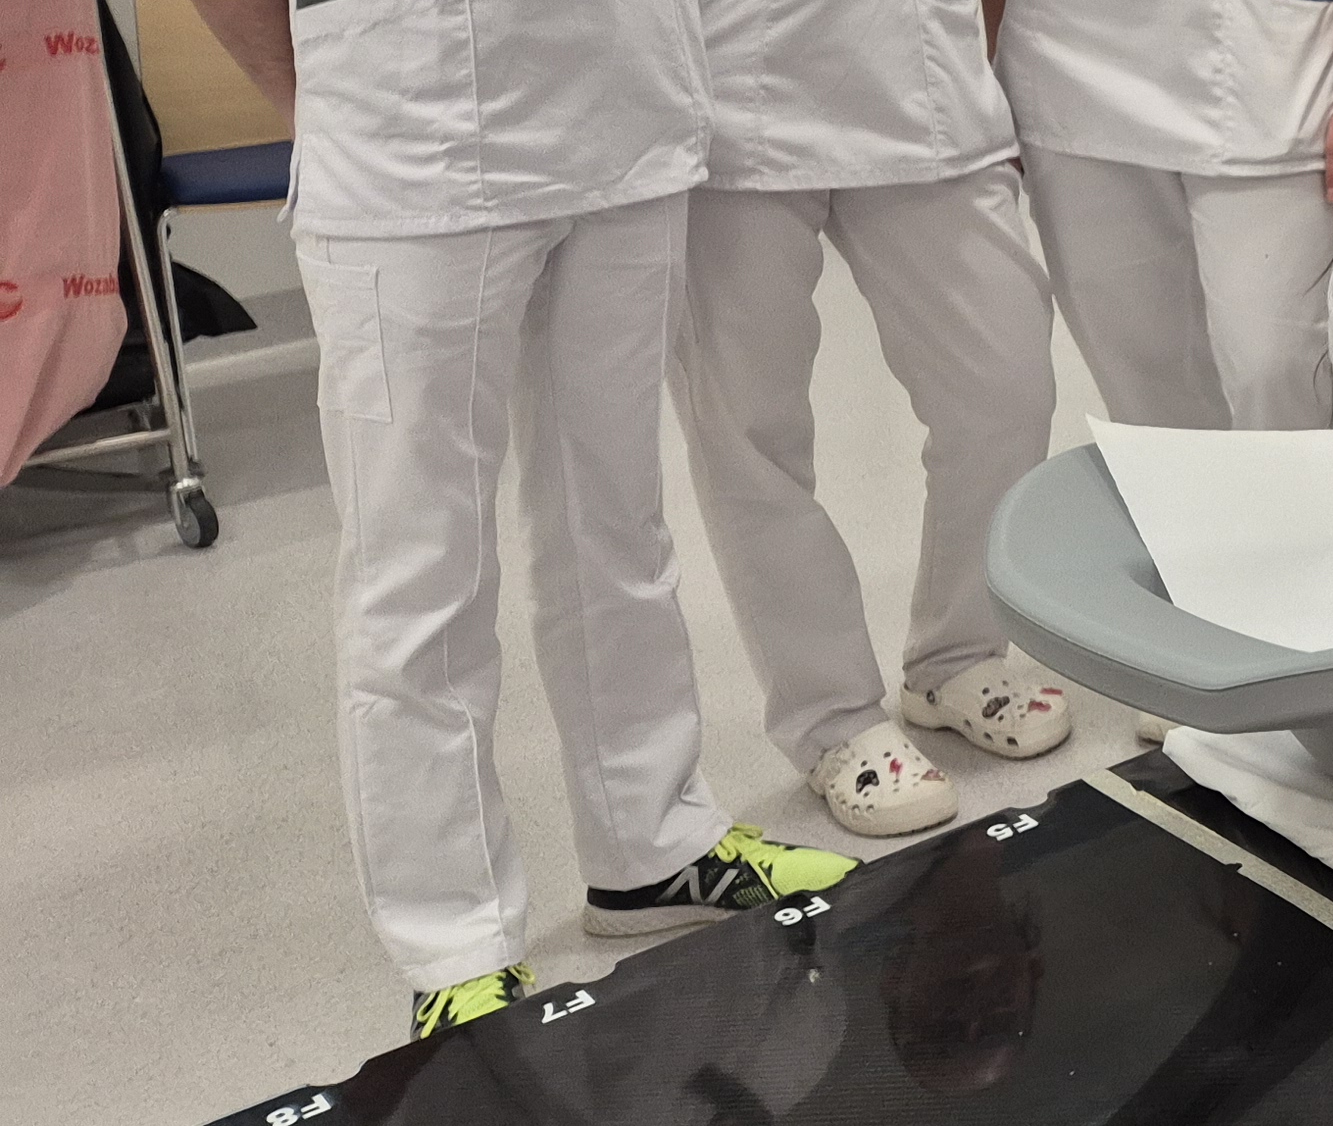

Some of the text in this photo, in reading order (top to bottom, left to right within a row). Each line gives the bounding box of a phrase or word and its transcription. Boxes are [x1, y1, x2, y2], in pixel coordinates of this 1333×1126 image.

[44, 30, 99, 57] Woz
[986, 814, 1039, 841] F5
[774, 896, 831, 926] F6
[541, 989, 597, 1024] F7
[266, 1093, 332, 1126] F8
